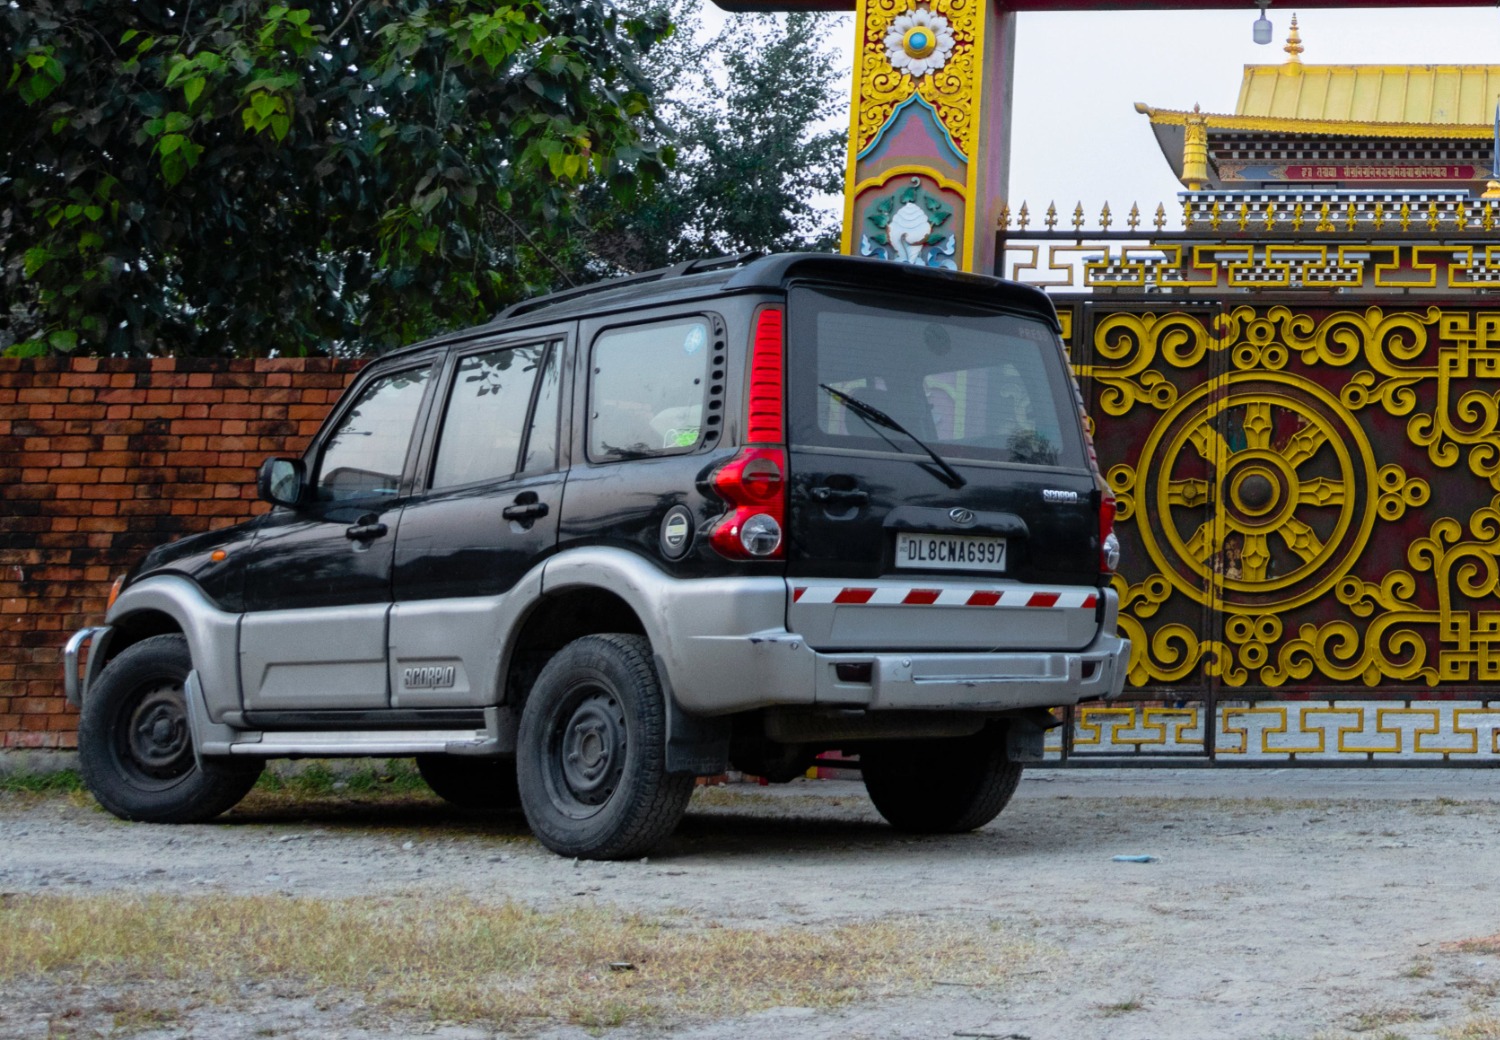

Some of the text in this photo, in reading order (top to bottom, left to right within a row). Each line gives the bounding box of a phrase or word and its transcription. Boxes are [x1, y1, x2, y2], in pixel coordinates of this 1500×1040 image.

[1043, 489, 1078, 504] SCORPIO
[908, 539, 1005, 564] DL8CNA6997
[404, 666, 456, 689] SCORPIO
